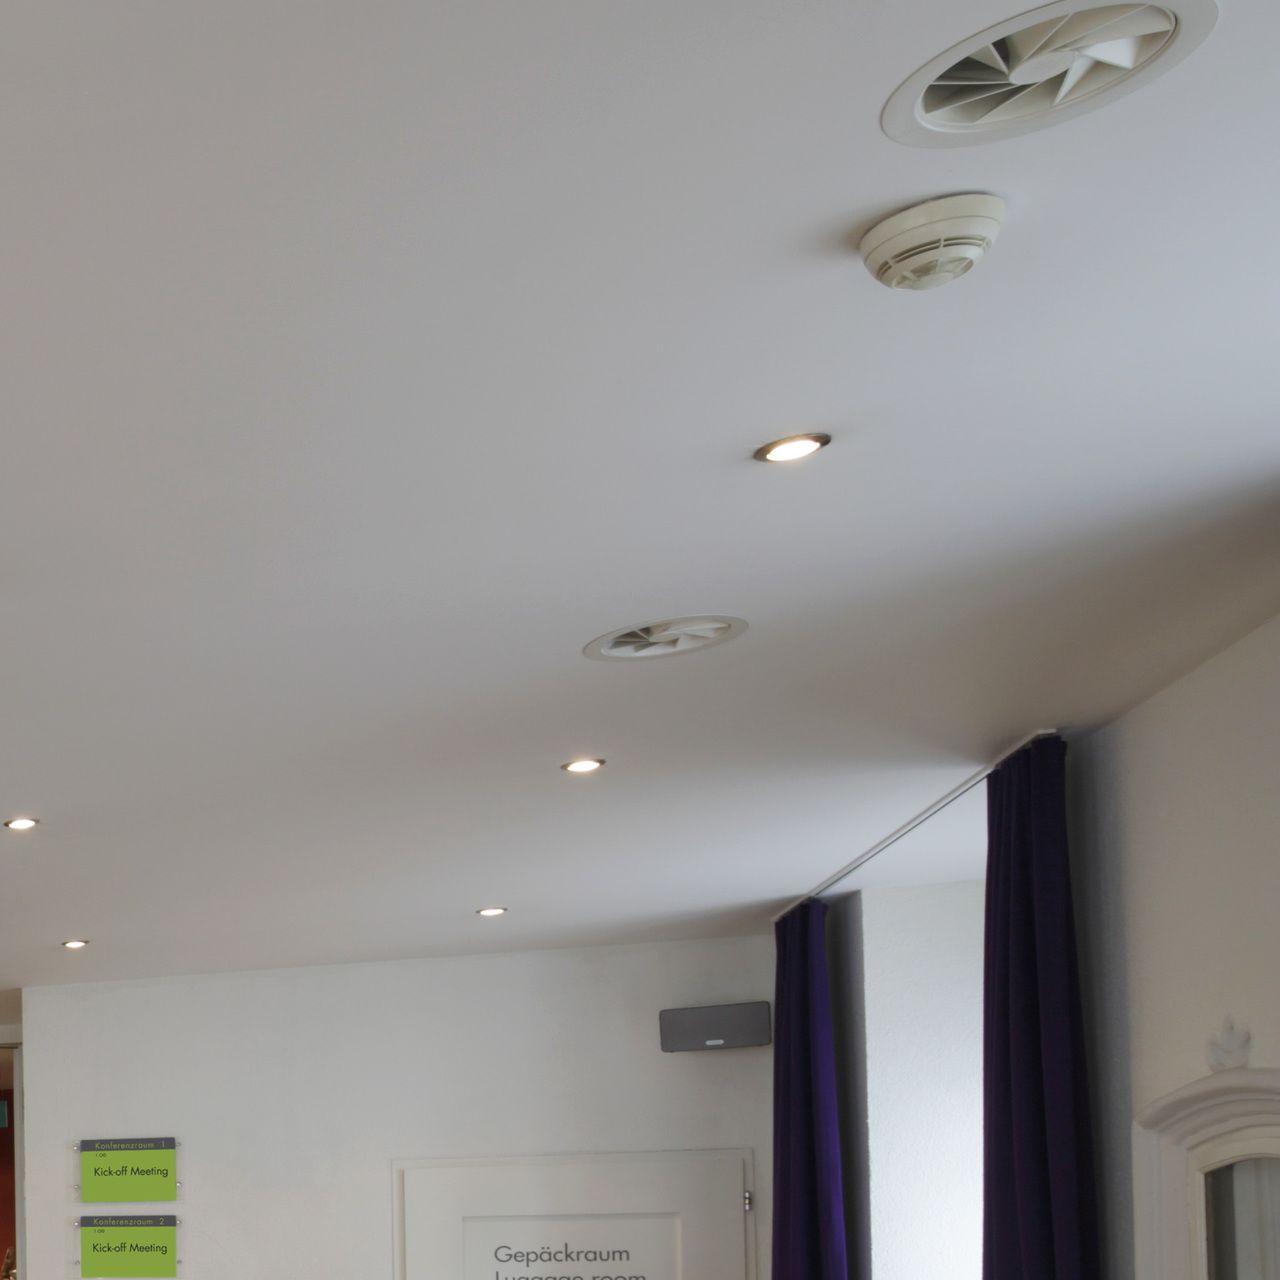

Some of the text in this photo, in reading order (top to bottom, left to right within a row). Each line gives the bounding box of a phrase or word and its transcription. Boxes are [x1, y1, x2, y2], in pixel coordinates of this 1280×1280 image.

[95, 1142, 154, 1150] Konferenzraum
[94, 1166, 169, 1178] Kick-off Meeting
[93, 1217, 165, 1225] Konferenzraum 2
[92, 1242, 168, 1255] Kick-off Meeting
[494, 1242, 630, 1268] Gepäckraum
